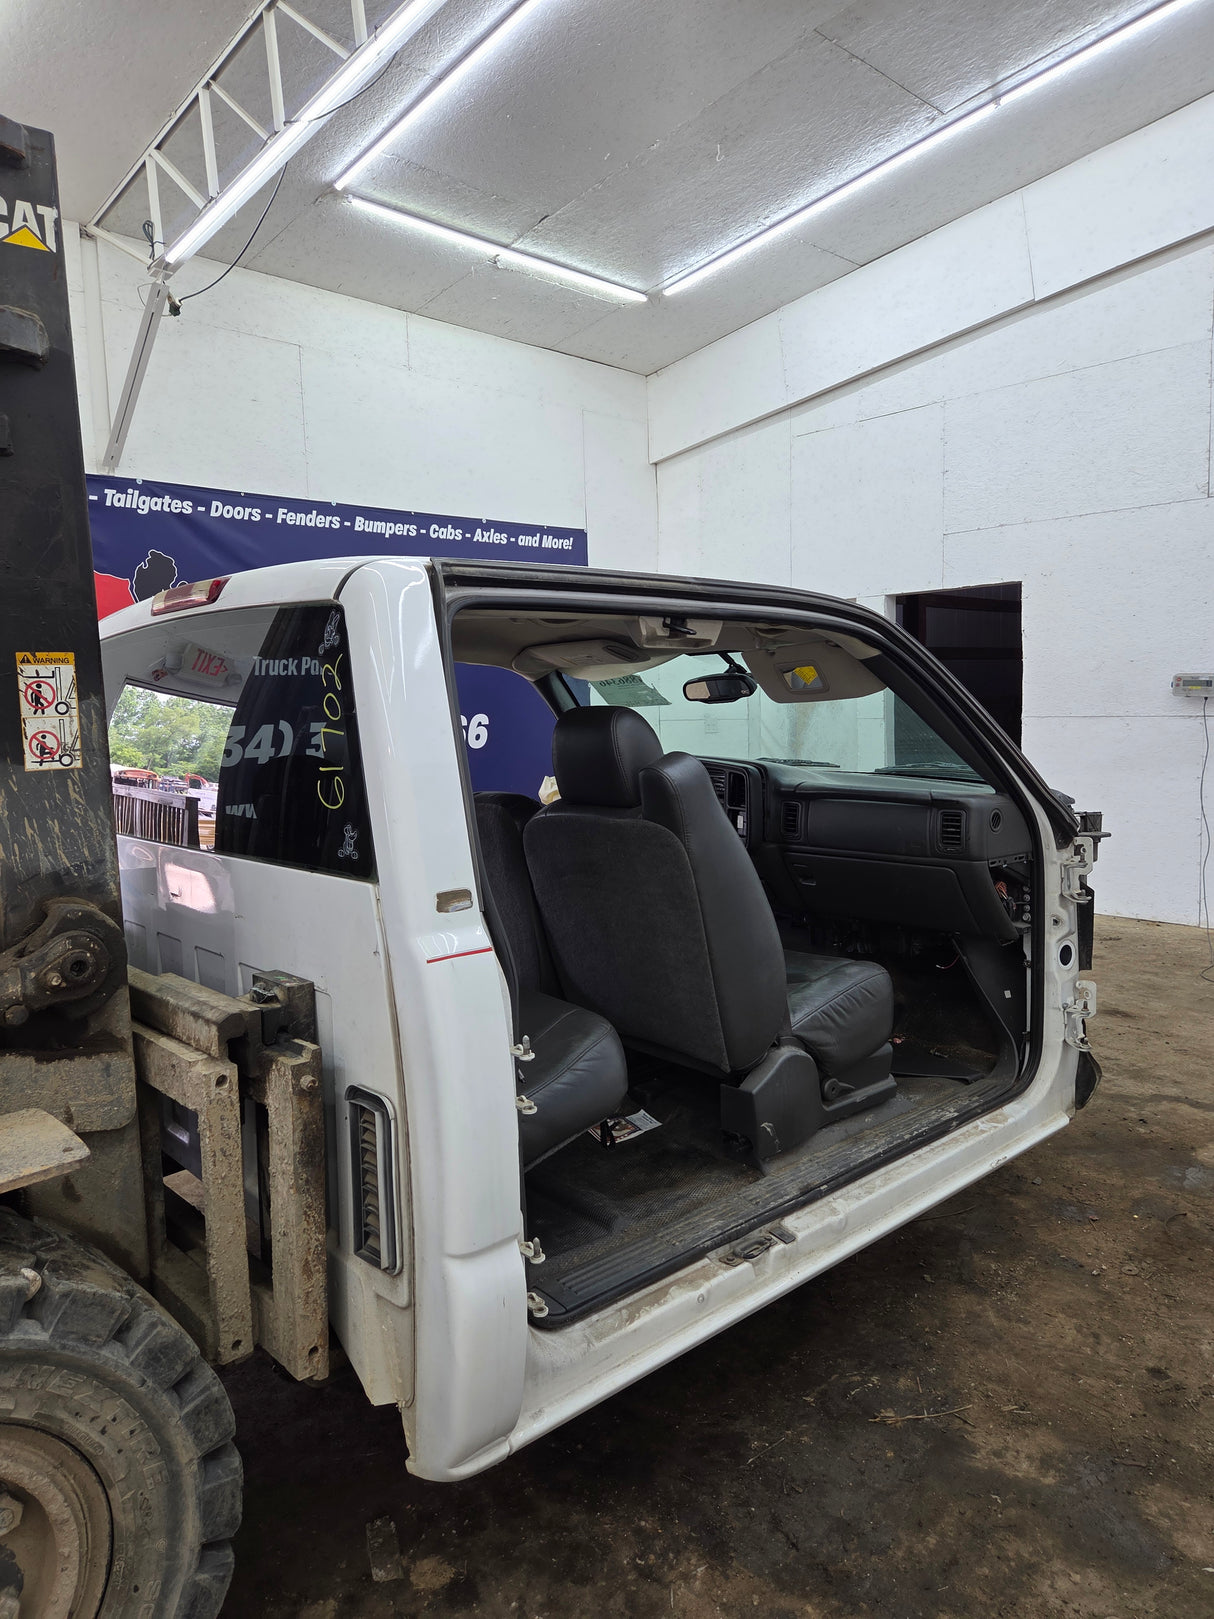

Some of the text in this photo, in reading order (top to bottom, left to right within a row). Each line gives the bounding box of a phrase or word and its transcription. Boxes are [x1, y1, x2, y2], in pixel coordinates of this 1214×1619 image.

[103, 488, 193, 515] Tailgates
[210, 500, 262, 522] Doors
[276, 508, 341, 529] Fenders
[354, 515, 418, 539] Bumpers
[429, 523, 463, 541] Cabs
[472, 528, 508, 545] Axles
[517, 532, 541, 548] and
[541, 534, 574, 550] More!
[252, 655, 299, 677] Truck
[317, 653, 345, 809] 61702
